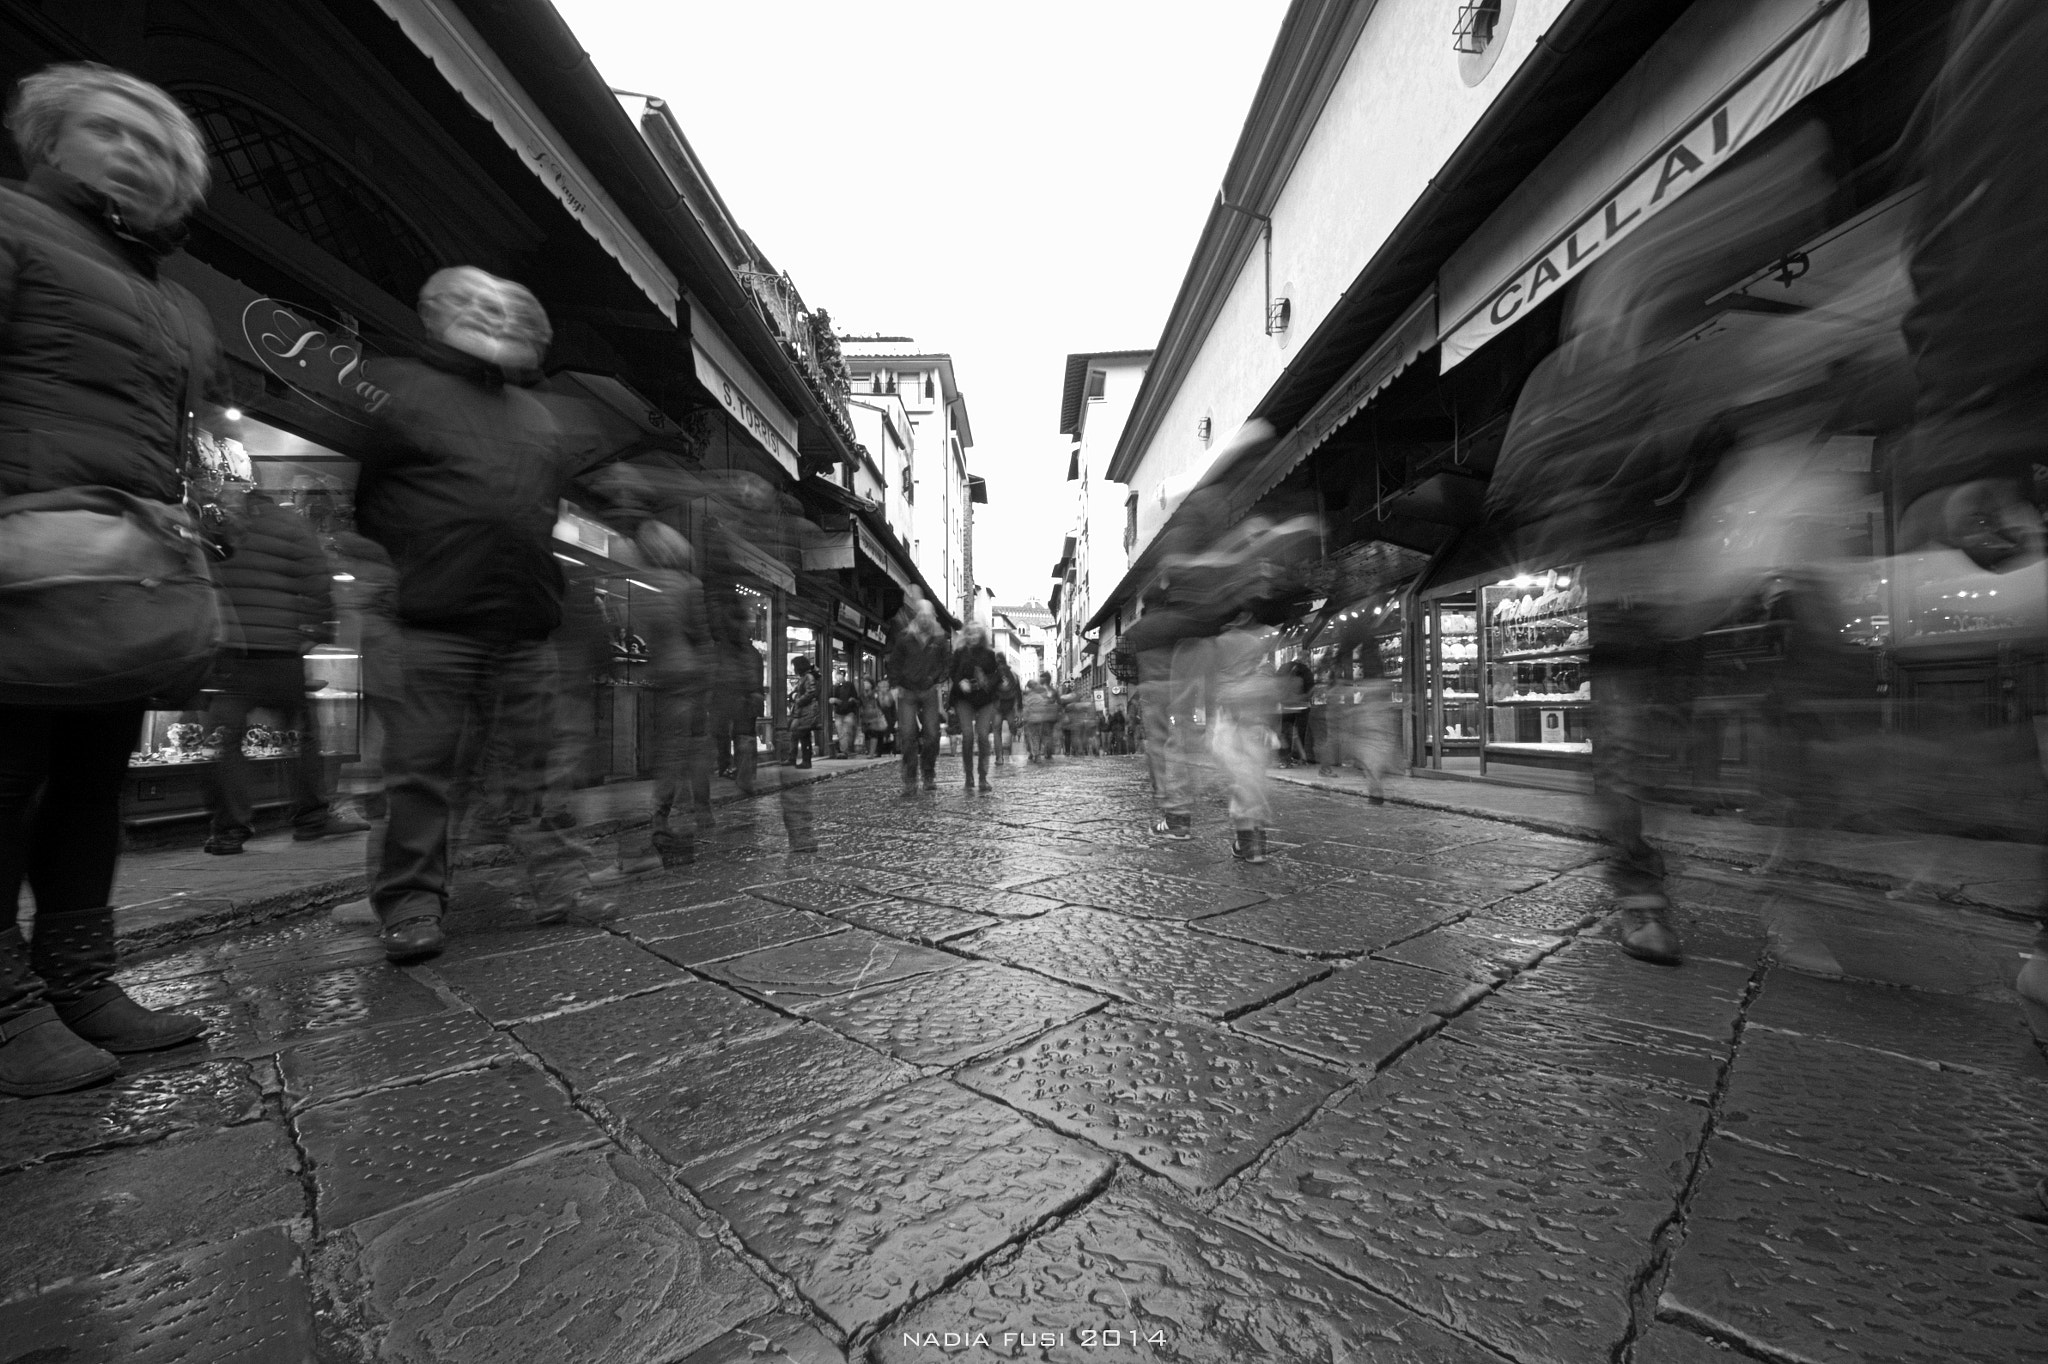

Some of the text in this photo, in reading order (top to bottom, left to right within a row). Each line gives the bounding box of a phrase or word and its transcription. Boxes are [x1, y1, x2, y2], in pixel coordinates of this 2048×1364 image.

[527, 139, 549, 168] S.
[1490, 105, 1729, 326] CALLAI
[329, 344, 392, 413] Vag
[722, 381, 780, 458] S. TORRISI
